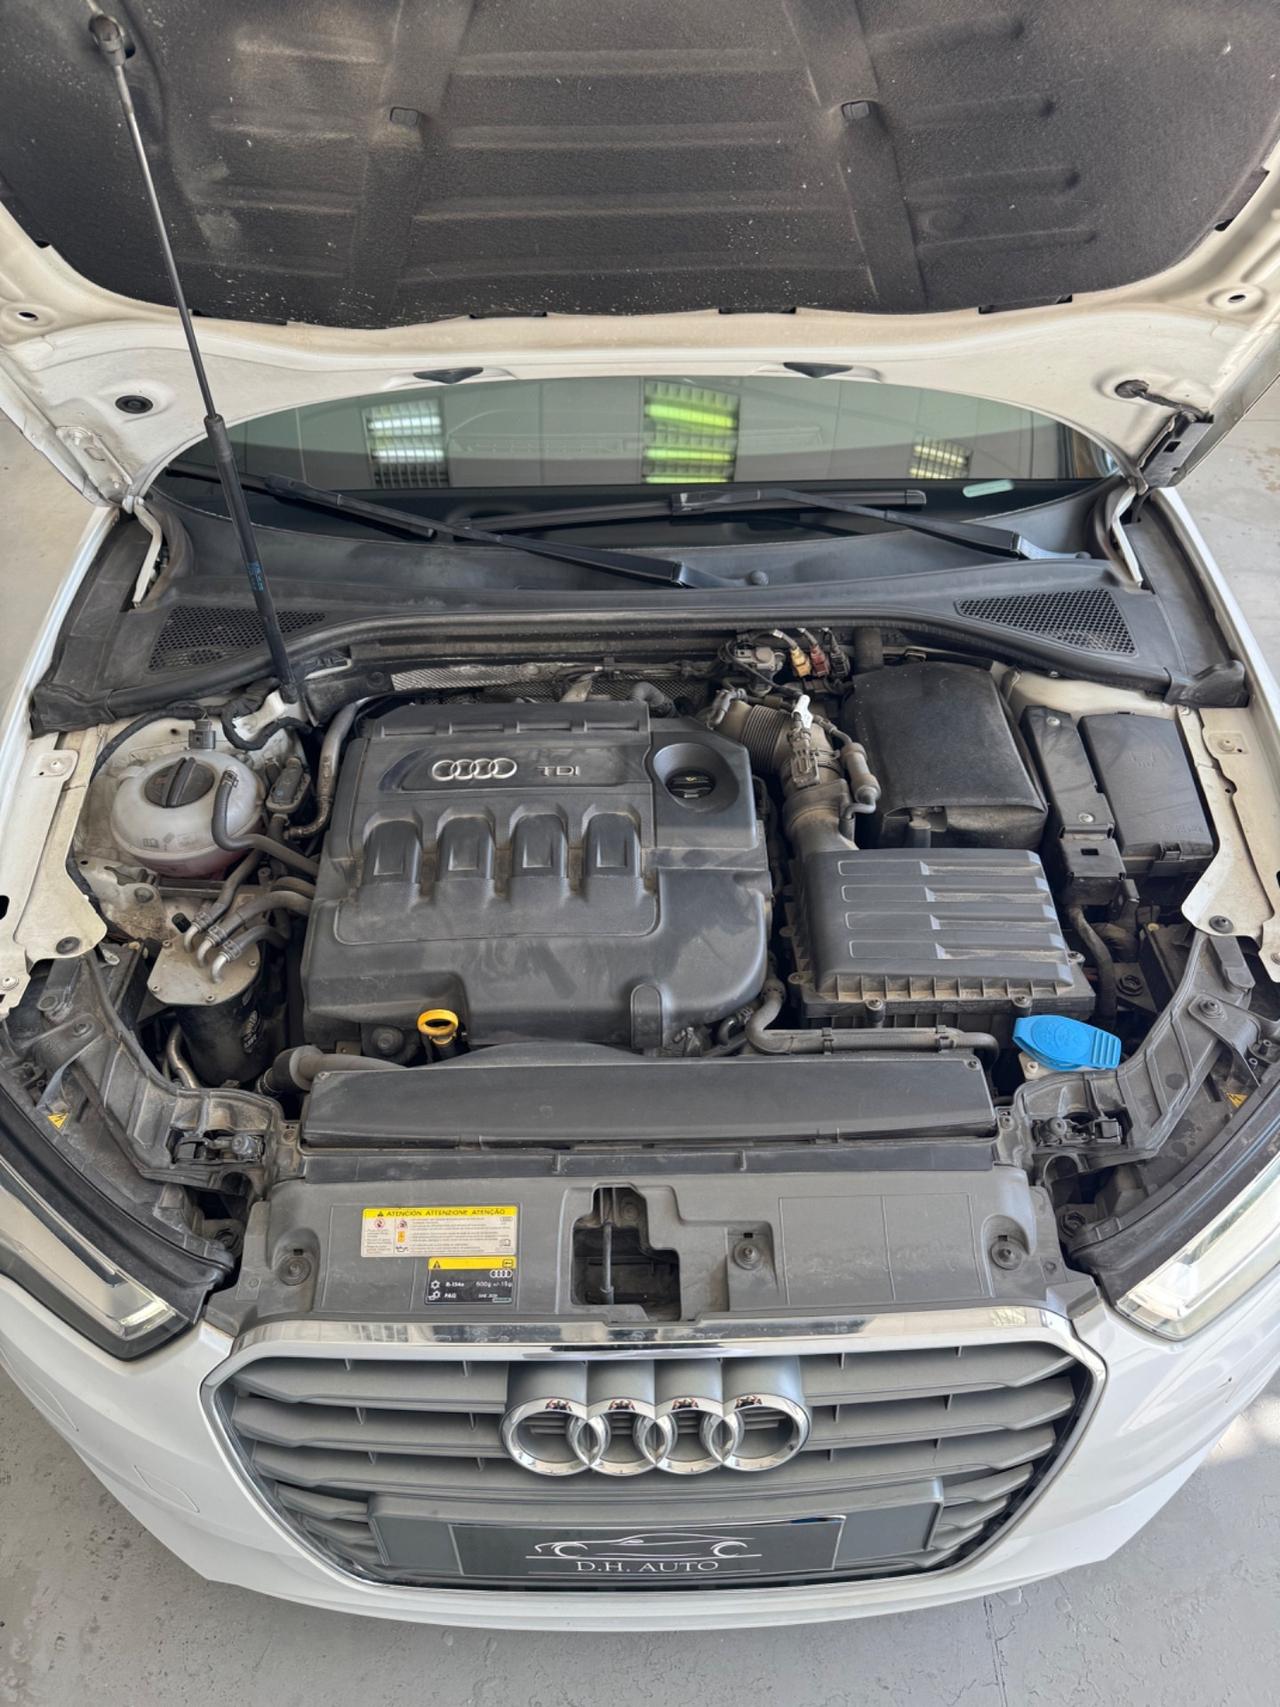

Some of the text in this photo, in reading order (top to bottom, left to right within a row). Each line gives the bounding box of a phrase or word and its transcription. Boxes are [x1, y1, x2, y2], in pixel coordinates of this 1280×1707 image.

[538, 766, 581, 776] TDI
[576, 1560, 719, 1572] D.H. AUTO
